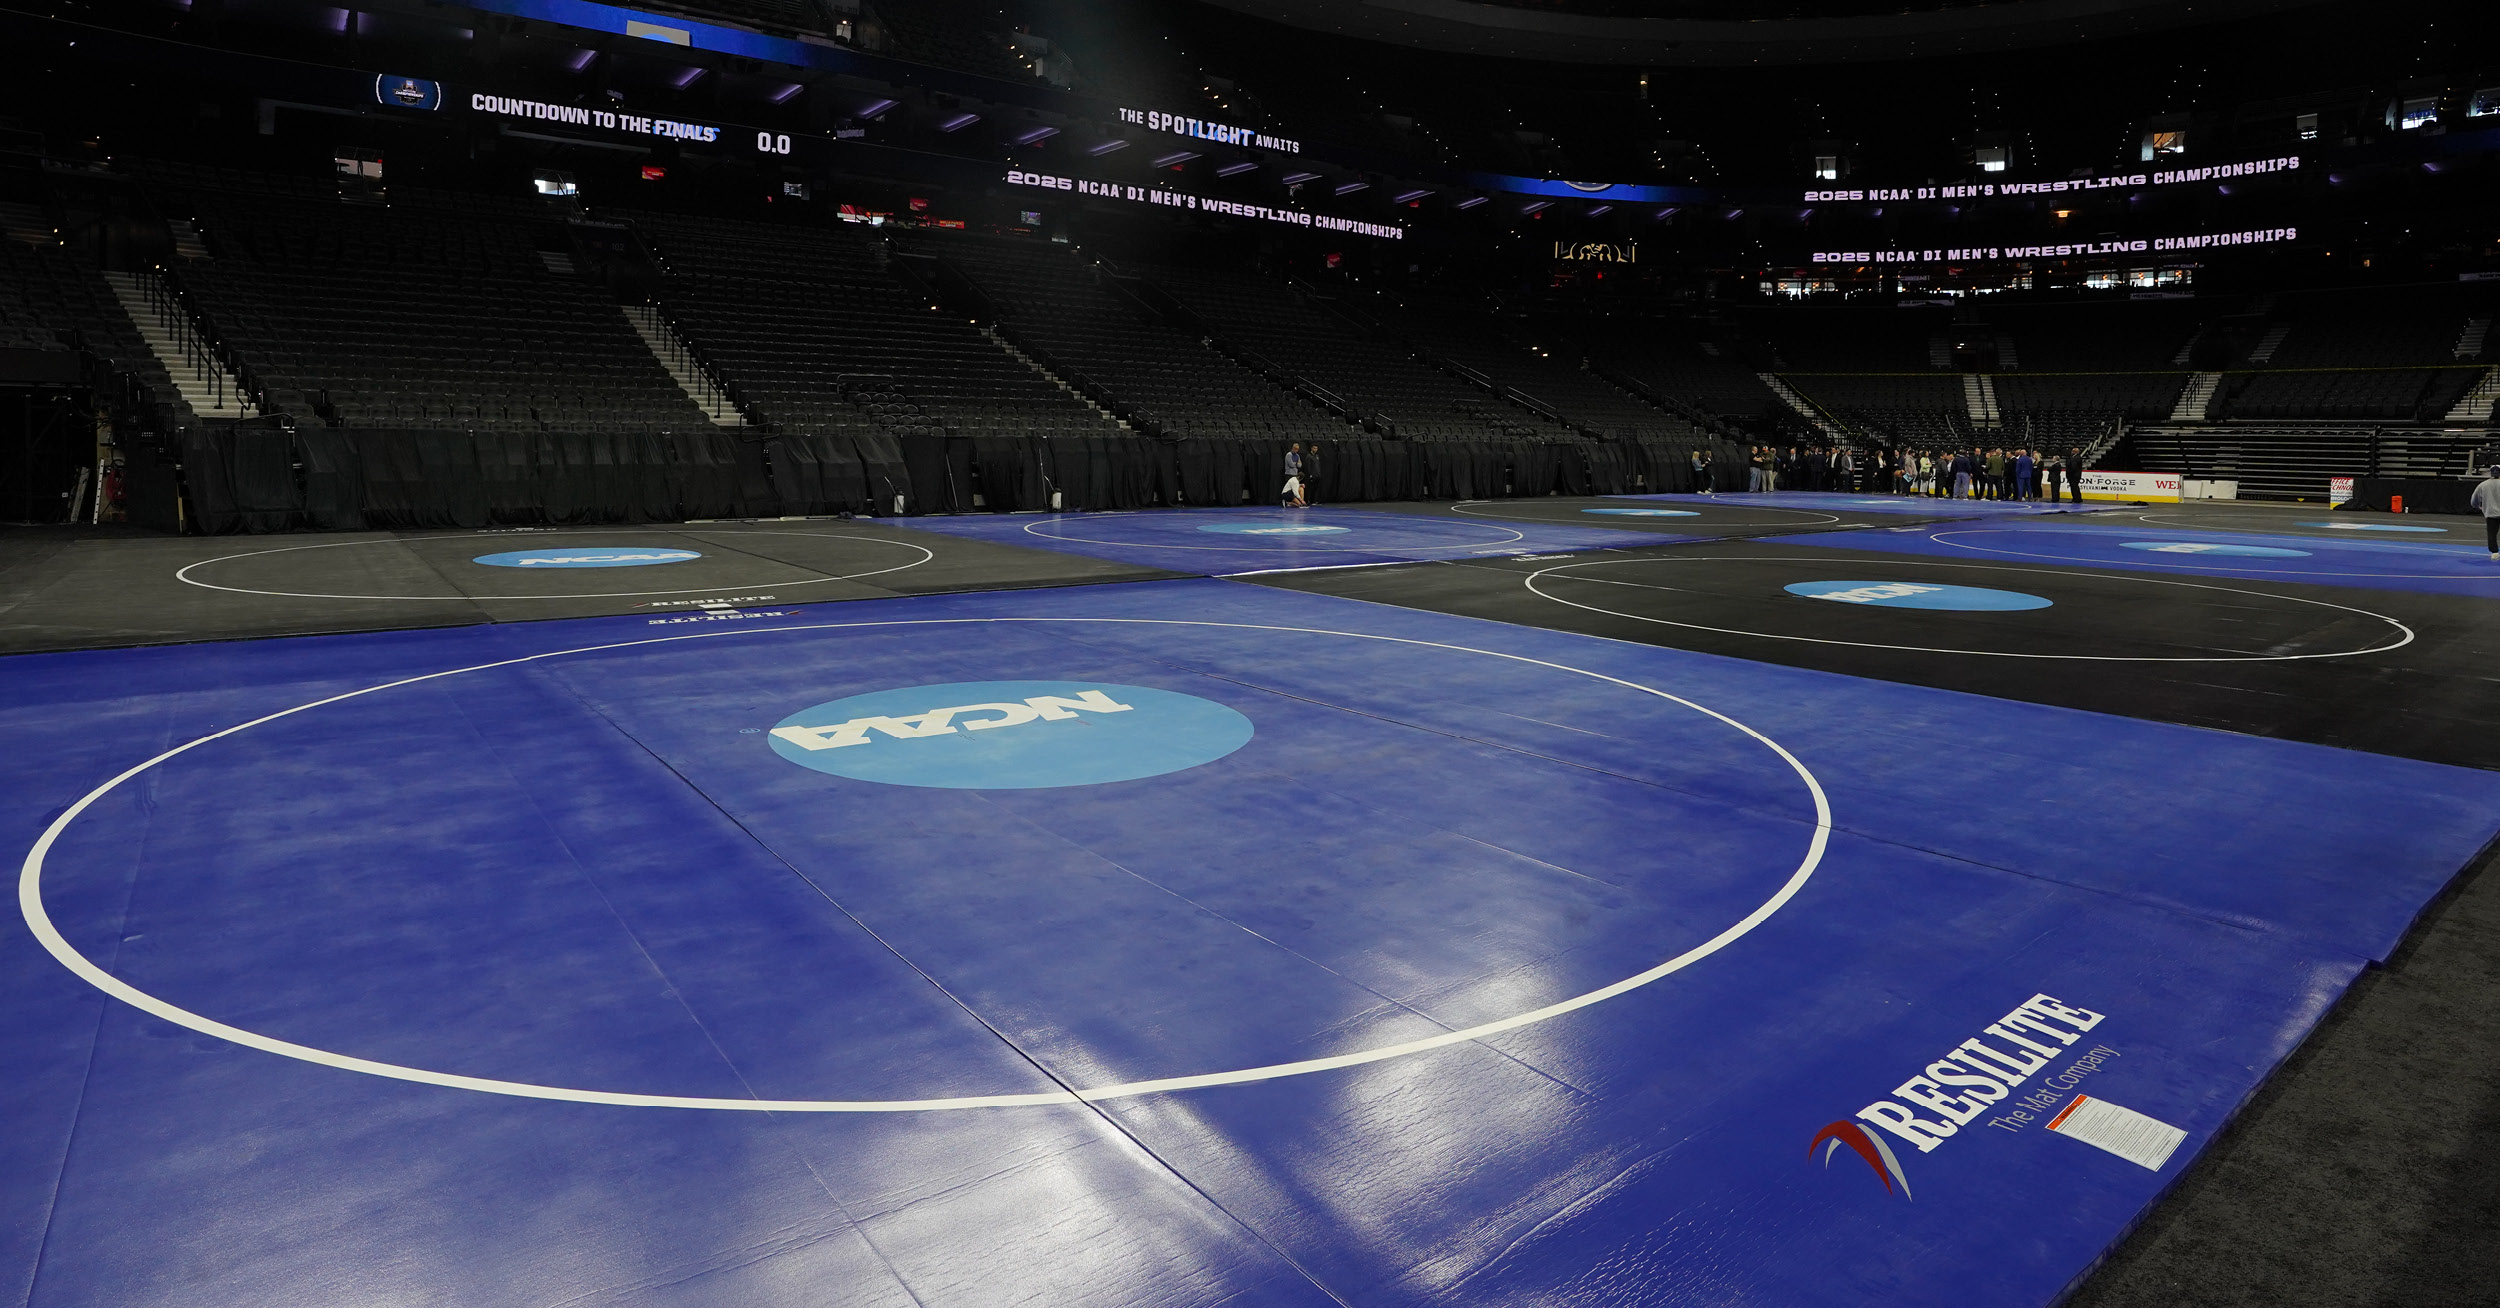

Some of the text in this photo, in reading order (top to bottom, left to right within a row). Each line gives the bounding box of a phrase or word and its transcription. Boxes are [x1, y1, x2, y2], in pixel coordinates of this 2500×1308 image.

[472, 94, 588, 124] COUNTDOWN
[593, 111, 615, 128] TO
[619, 115, 651, 133] THE
[653, 119, 720, 142] FINALS
[1120, 108, 1299, 153] THE SPOTLIGHT AWAITS
[758, 132, 790, 154] 0.0
[1805, 191, 1863, 201] 2025
[1918, 188, 1935, 199] DI
[1943, 185, 1994, 197] MEN'S
[2001, 174, 2146, 195] WRESTLING
[2154, 156, 2299, 185] CHAMPIONSHIPS
[1008, 171, 1072, 190] 2025
[1128, 187, 1144, 201] DI
[1151, 188, 1195, 208] MEN'S
[1202, 198, 1311, 226] WRESTLING
[1315, 216, 1402, 239] CHAMPIONSHIPS
[1813, 253, 1870, 262] 2025
[1924, 250, 1941, 260] DI
[1948, 248, 1998, 261] MEN'S
[2005, 240, 2147, 259] WRESTLING
[2155, 227, 2296, 250] CHAMPIONSHIPS
[519, 553, 701, 565] NCAA
[649, 611, 784, 624] RESILITE
[651, 595, 775, 606] RESILITE
[769, 689, 1134, 751] NCAA
[1855, 993, 2106, 1154] RESILITE
[1987, 1044, 2121, 1133] The Mat Company
